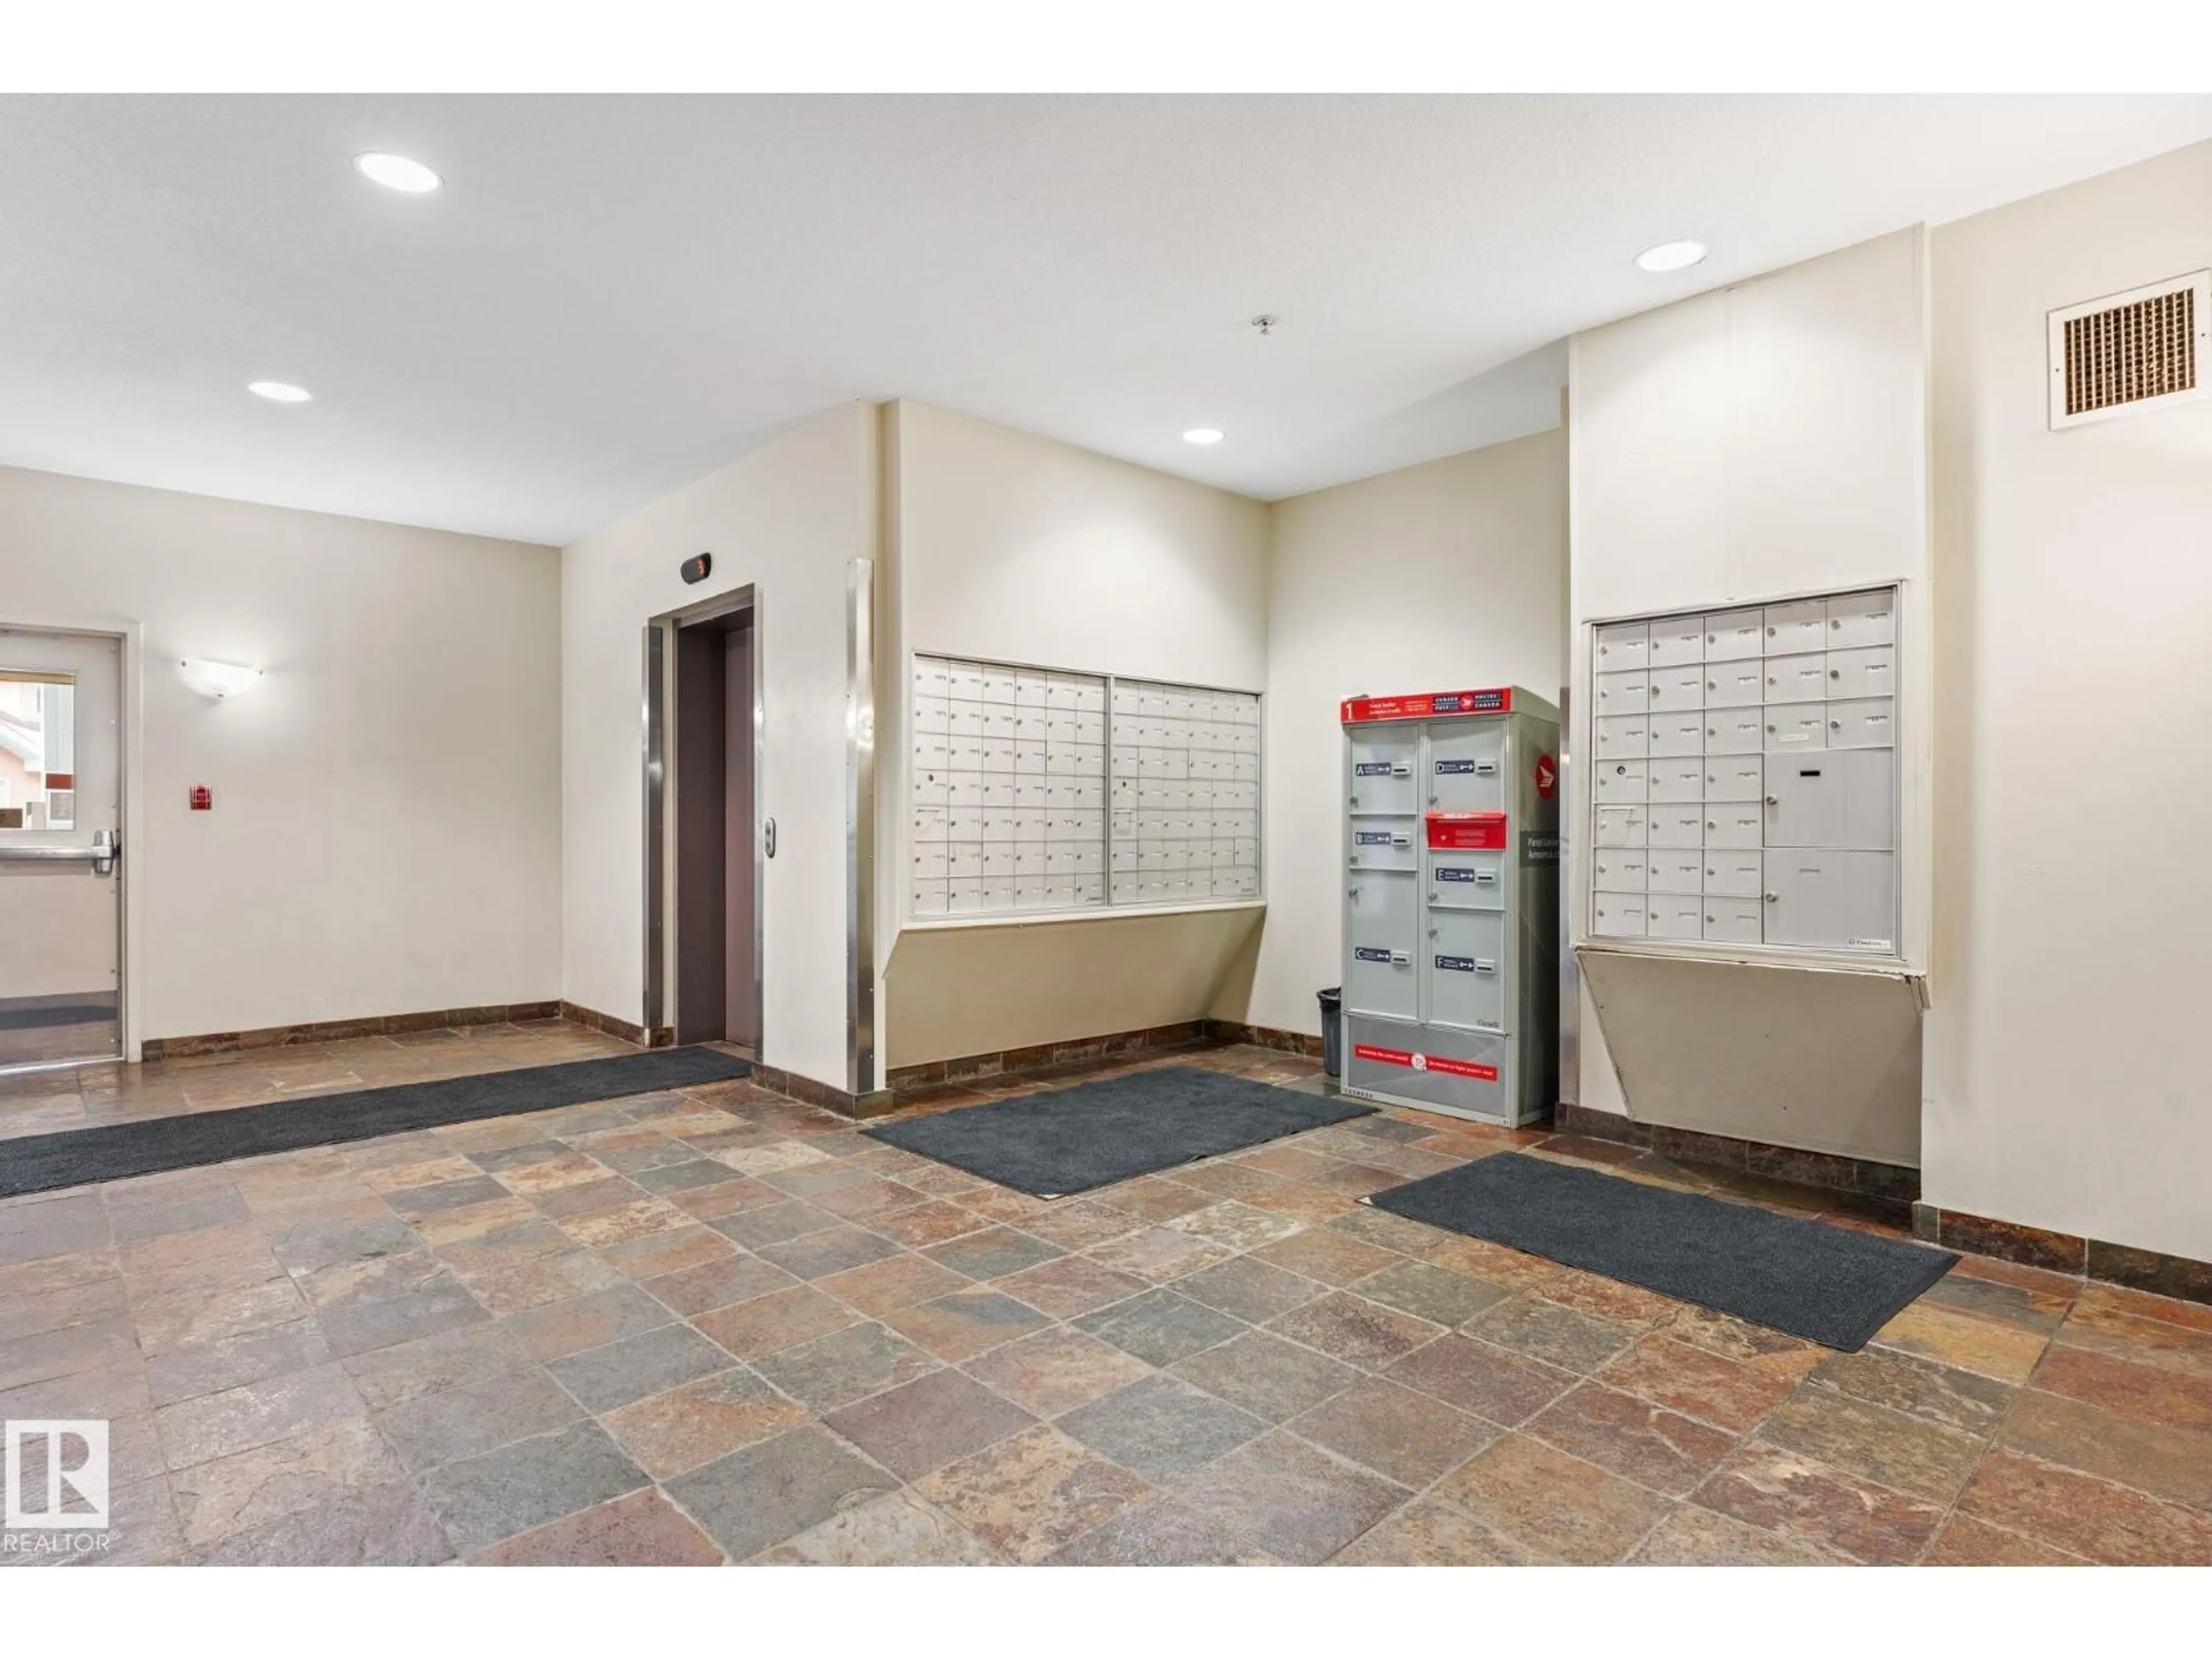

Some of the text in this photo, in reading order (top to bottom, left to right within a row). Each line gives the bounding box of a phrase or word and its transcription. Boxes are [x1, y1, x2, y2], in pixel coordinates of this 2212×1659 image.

[1347, 702, 1353, 719] 1
[1357, 766, 1364, 775] A
[1437, 763, 1444, 774] D
[1357, 834, 1362, 843] B
[1438, 870, 1444, 880] E
[1357, 949, 1364, 959] C
[1438, 957, 1444, 967] F
